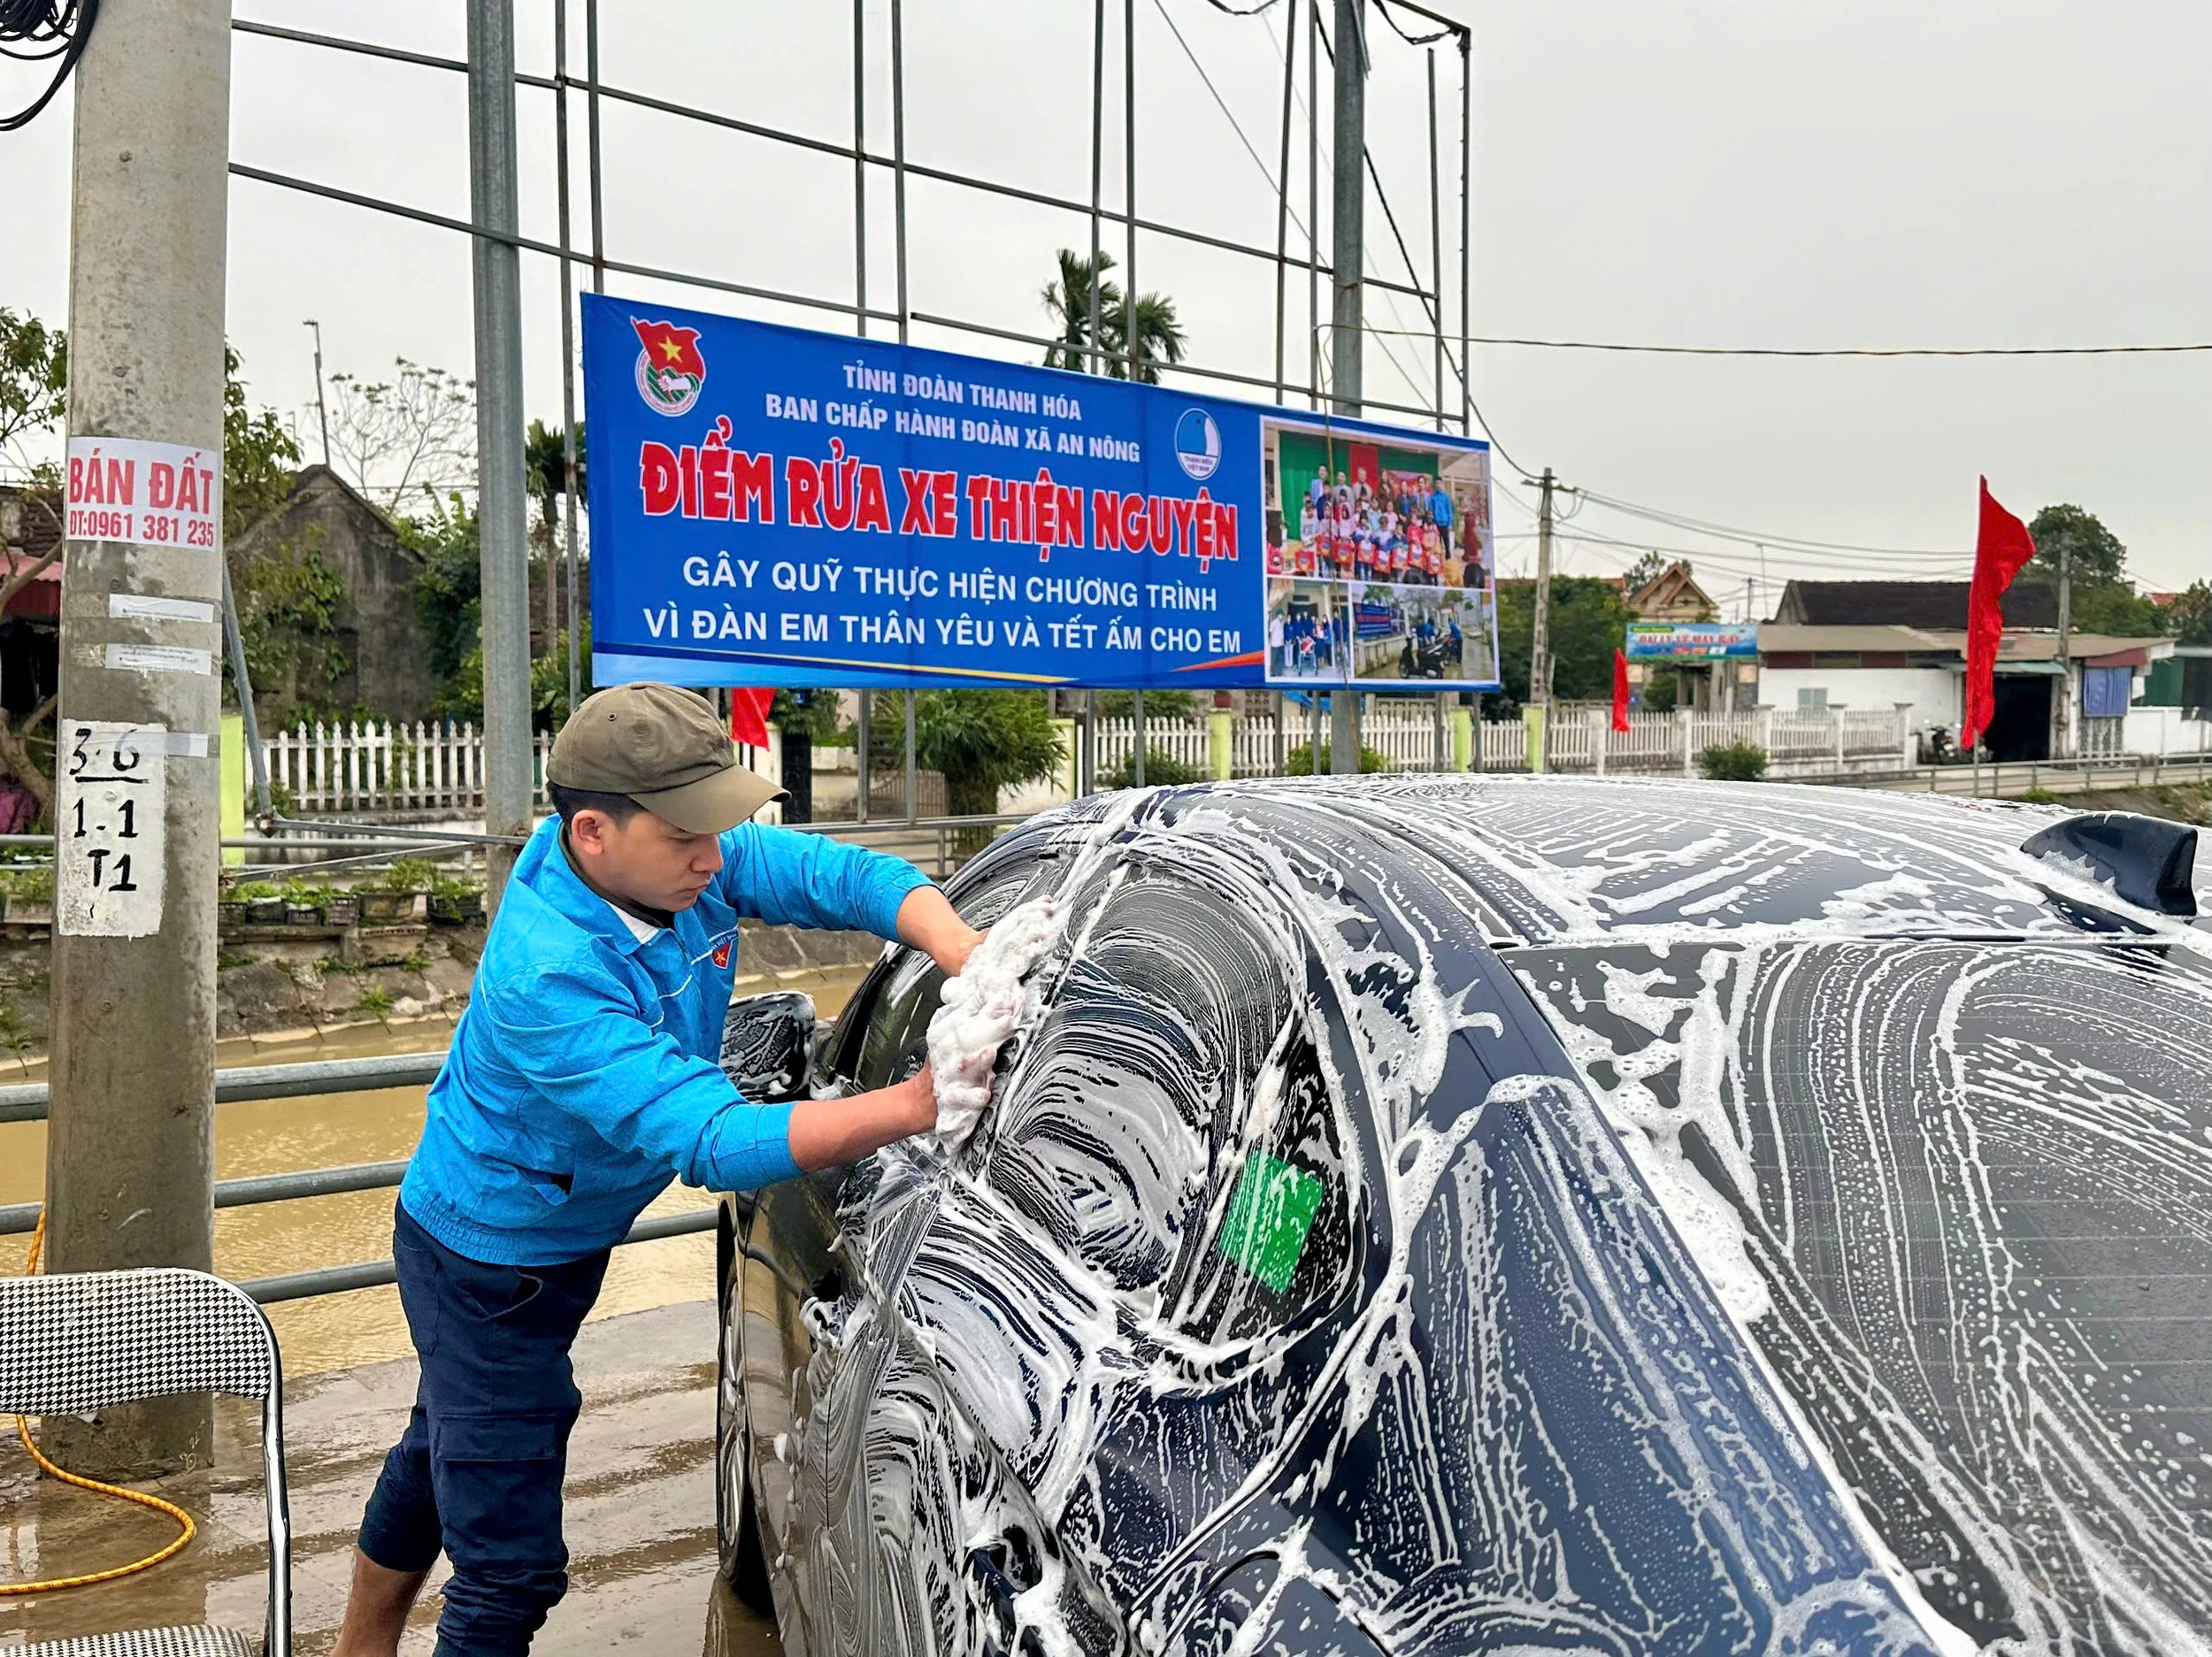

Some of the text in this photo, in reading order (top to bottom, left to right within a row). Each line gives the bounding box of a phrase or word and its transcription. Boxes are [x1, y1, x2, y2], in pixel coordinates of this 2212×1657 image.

[843, 359, 1082, 421] TỈNH ĐOÀN THANH HÓA
[766, 393, 1141, 463] BAN CHẤP HÀNH ĐOÀN XÃ AN NÔNG
[69, 448, 213, 515] BÁN ĐẤT
[640, 415, 1239, 574] ĐIỂM RỬA XE THIỆN NGUYỆN
[142, 515, 179, 542] 381
[187, 519, 214, 547] 235
[683, 550, 1217, 611] GÂY QUỸ THỰC HIỆN CHƯƠNG TRÌNH
[643, 602, 1241, 654] VÌ ĐÀN EM THÂN YÊU VÀ TẾT ẤM CHO EM
